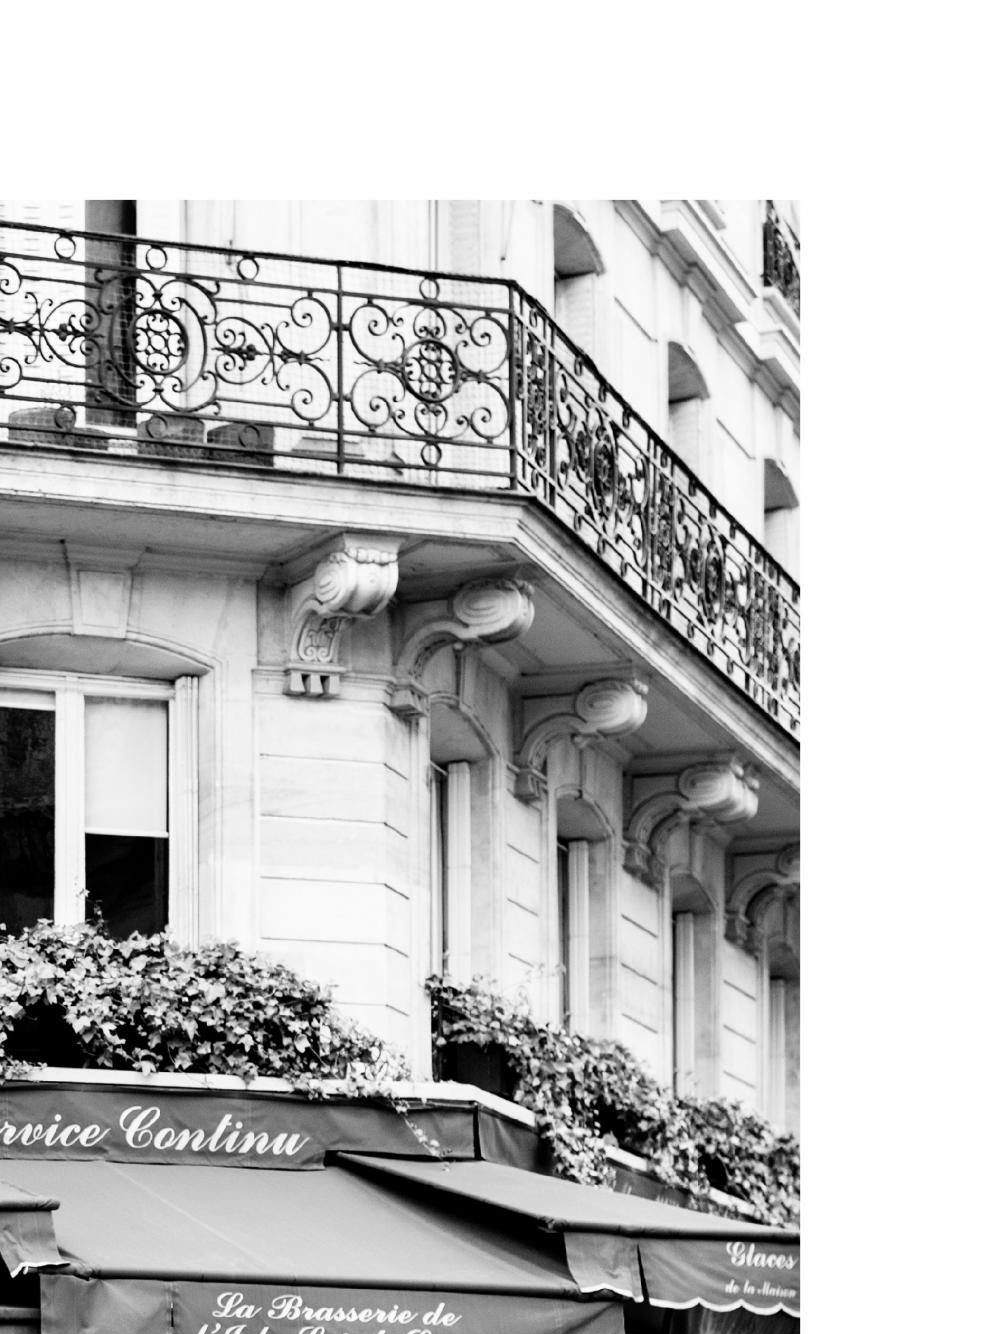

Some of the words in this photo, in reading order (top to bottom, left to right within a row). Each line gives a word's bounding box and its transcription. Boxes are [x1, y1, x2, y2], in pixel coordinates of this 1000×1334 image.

[119, 1105, 309, 1157] Continu
[726, 1241, 799, 1270] Glaces
[725, 1280, 740, 1294] de
[744, 1280, 755, 1295] la
[757, 1281, 797, 1298] Maison
[212, 1292, 262, 1319] La
[268, 1294, 418, 1324] Brasserie
[422, 1302, 463, 1327] de
